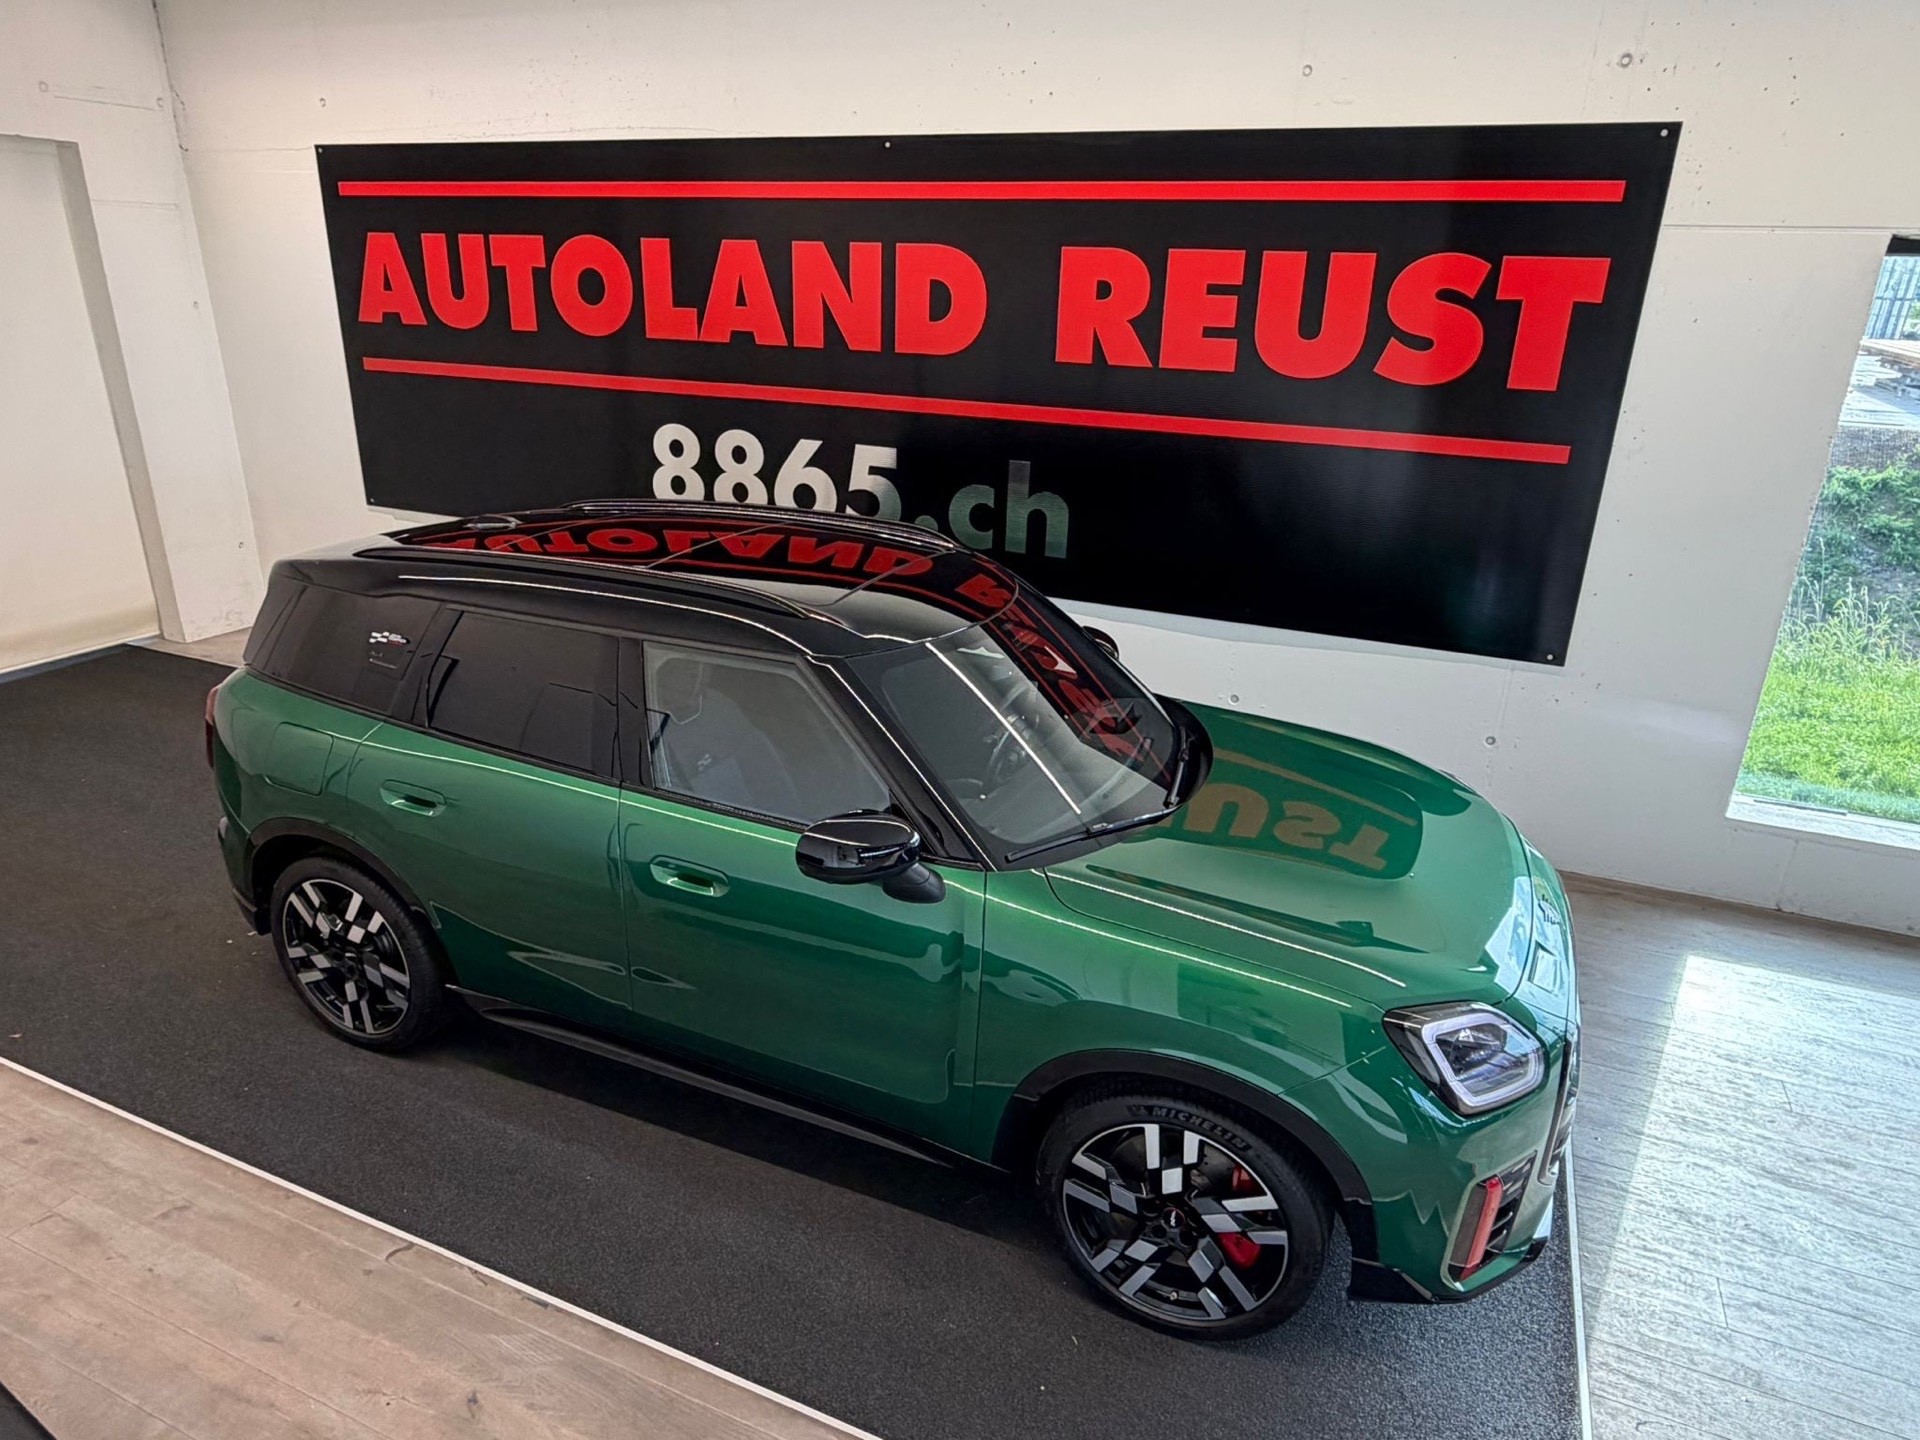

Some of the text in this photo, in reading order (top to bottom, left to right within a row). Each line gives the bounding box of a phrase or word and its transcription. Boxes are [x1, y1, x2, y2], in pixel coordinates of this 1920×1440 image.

[358, 231, 1612, 392] AUTOLAND REUST
[652, 423, 1069, 559] 8865.ch
[1152, 1106, 1249, 1149] MICHELIN
